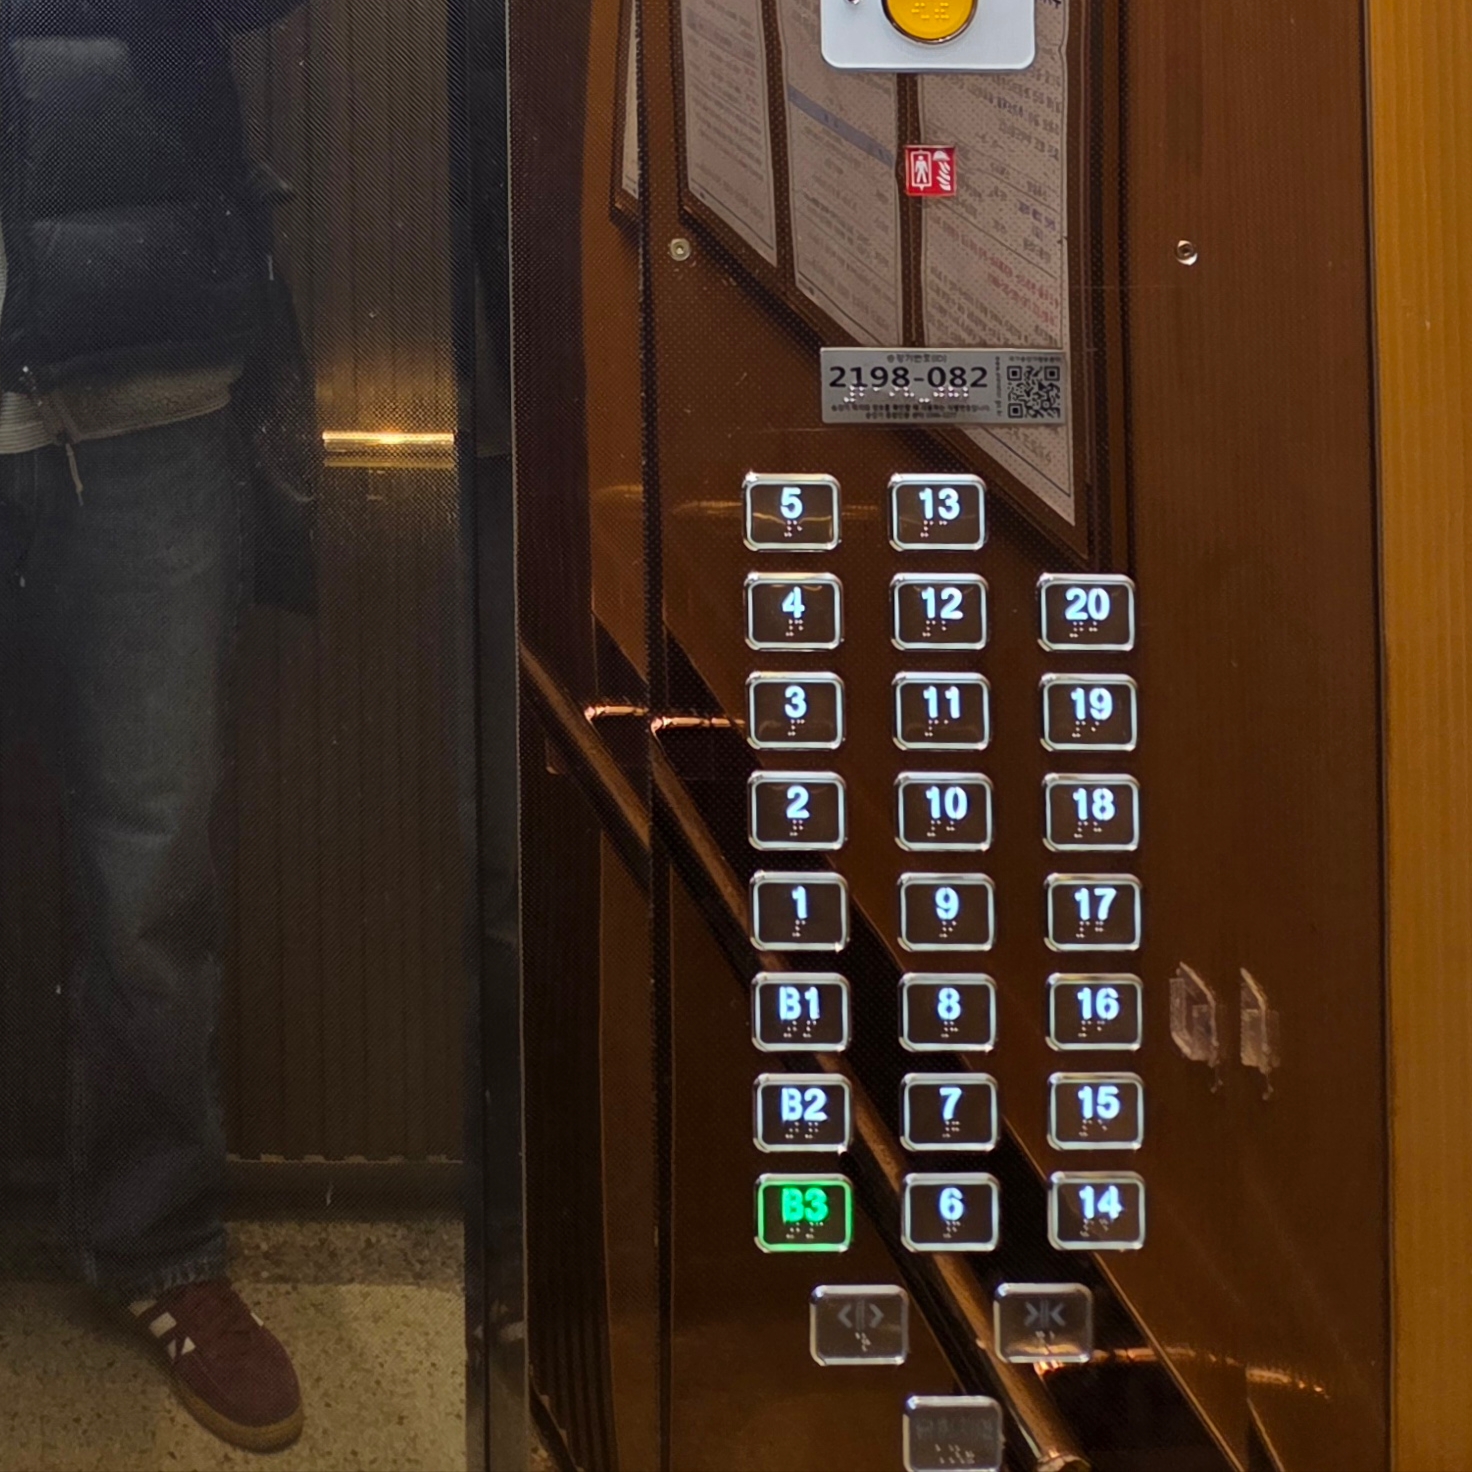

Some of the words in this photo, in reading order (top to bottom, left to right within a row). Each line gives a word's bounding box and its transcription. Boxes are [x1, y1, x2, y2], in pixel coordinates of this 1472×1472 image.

[829, 367, 987, 387] 2198-082
[779, 487, 802, 519] 5
[919, 487, 960, 520] 13
[781, 587, 805, 619] 4
[922, 587, 964, 620] 12
[1064, 587, 1110, 621] 20
[784, 686, 807, 718] 3
[924, 687, 960, 719] 11
[1071, 687, 1113, 721] 19
[786, 785, 810, 819] 2
[927, 786, 967, 820] 10
[1073, 788, 1115, 821] 18
[791, 885, 807, 919] 1
[935, 887, 958, 921] 9
[1074, 887, 1117, 921] 17
[778, 986, 820, 1020] B1
[937, 987, 961, 1020] 8
[1077, 987, 1120, 1020] 16
[780, 1087, 827, 1122] B2
[939, 1087, 962, 1121] 7
[1078, 1086, 1120, 1119] 15
[781, 1187, 828, 1222] B3
[939, 1187, 964, 1220] 6
[1078, 1185, 1122, 1219] 14
